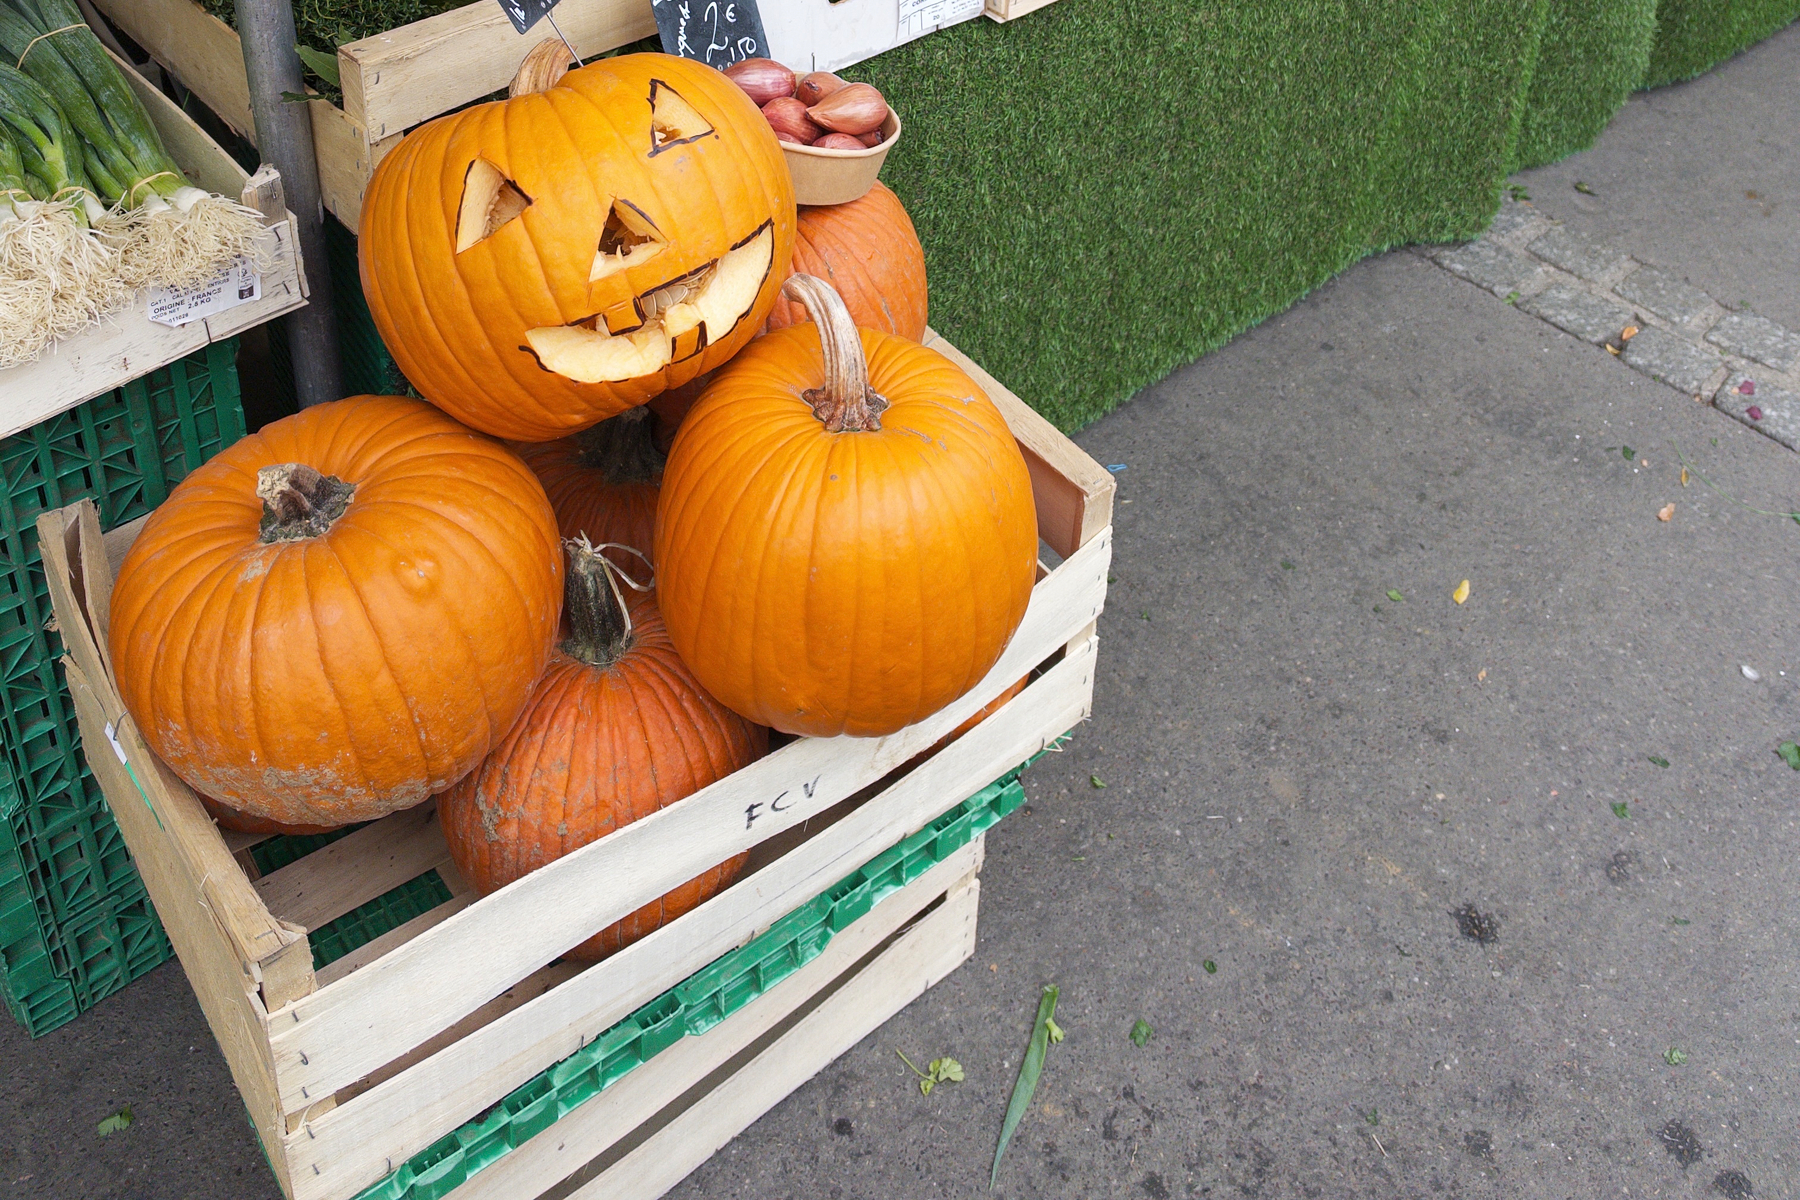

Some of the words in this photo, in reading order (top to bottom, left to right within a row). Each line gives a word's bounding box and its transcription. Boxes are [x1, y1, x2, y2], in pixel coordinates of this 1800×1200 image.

[151, 311, 168, 320] POIDS
[168, 307, 180, 316] NET
[199, 297, 212, 307] KG
[153, 300, 186, 315] ORIGINE
[191, 287, 222, 302] FRANCE
